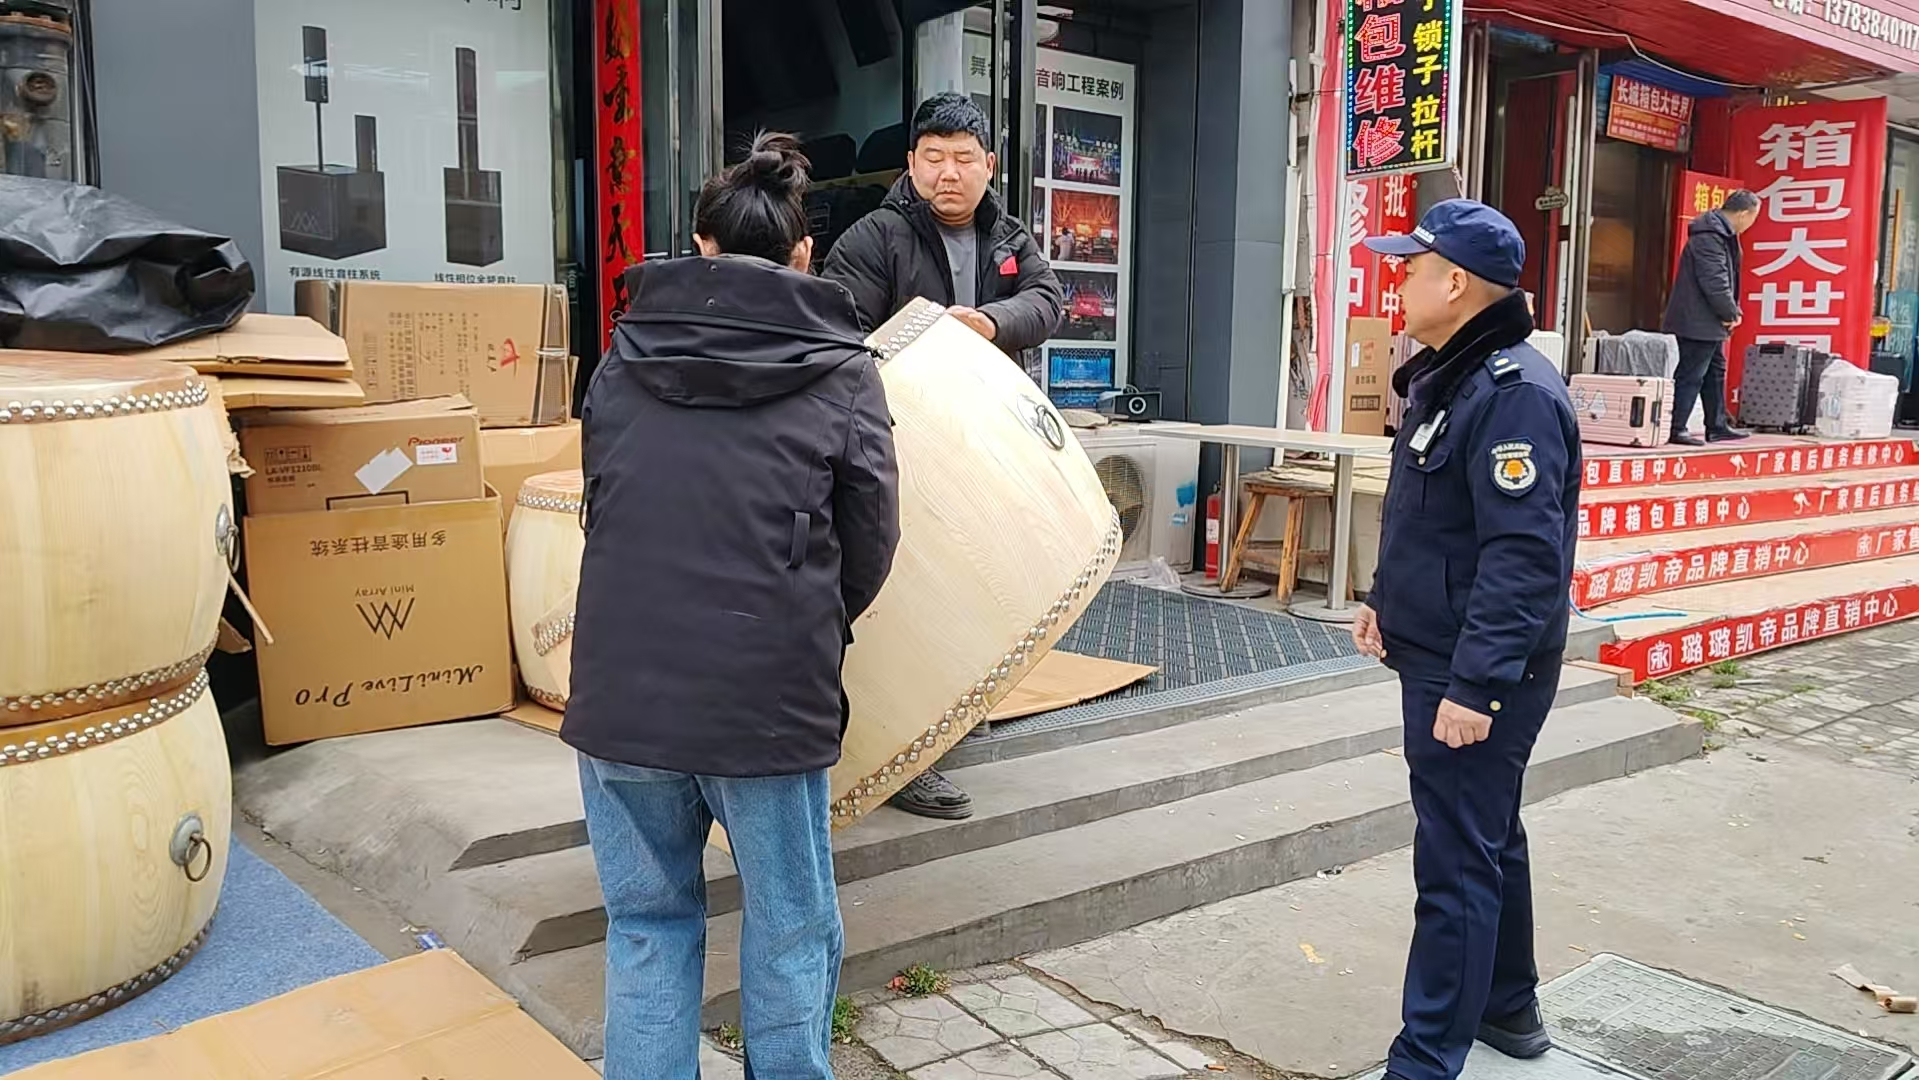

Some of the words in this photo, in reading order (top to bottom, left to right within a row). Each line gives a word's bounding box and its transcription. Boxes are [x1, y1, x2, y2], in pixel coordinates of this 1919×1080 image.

[1036, 68, 1124, 100] 音响工程案例
[1616, 76, 1690, 119] 长城箱包大世界
[1694, 181, 1737, 212] 箱包
[1754, 443, 1905, 475] 厂家售后服务维修中心
[1577, 496, 1751, 537] 品牌箱包直销中心
[309, 530, 447, 557] 多用途音柱系统
[1586, 542, 1810, 600] 璐璐凯帝品牌直销中心
[355, 586, 387, 598] Array
[391, 584, 415, 594] Mini
[1681, 593, 1899, 665] 璐璐凯帝品牌直销中心
[294, 683, 353, 708] Pro
